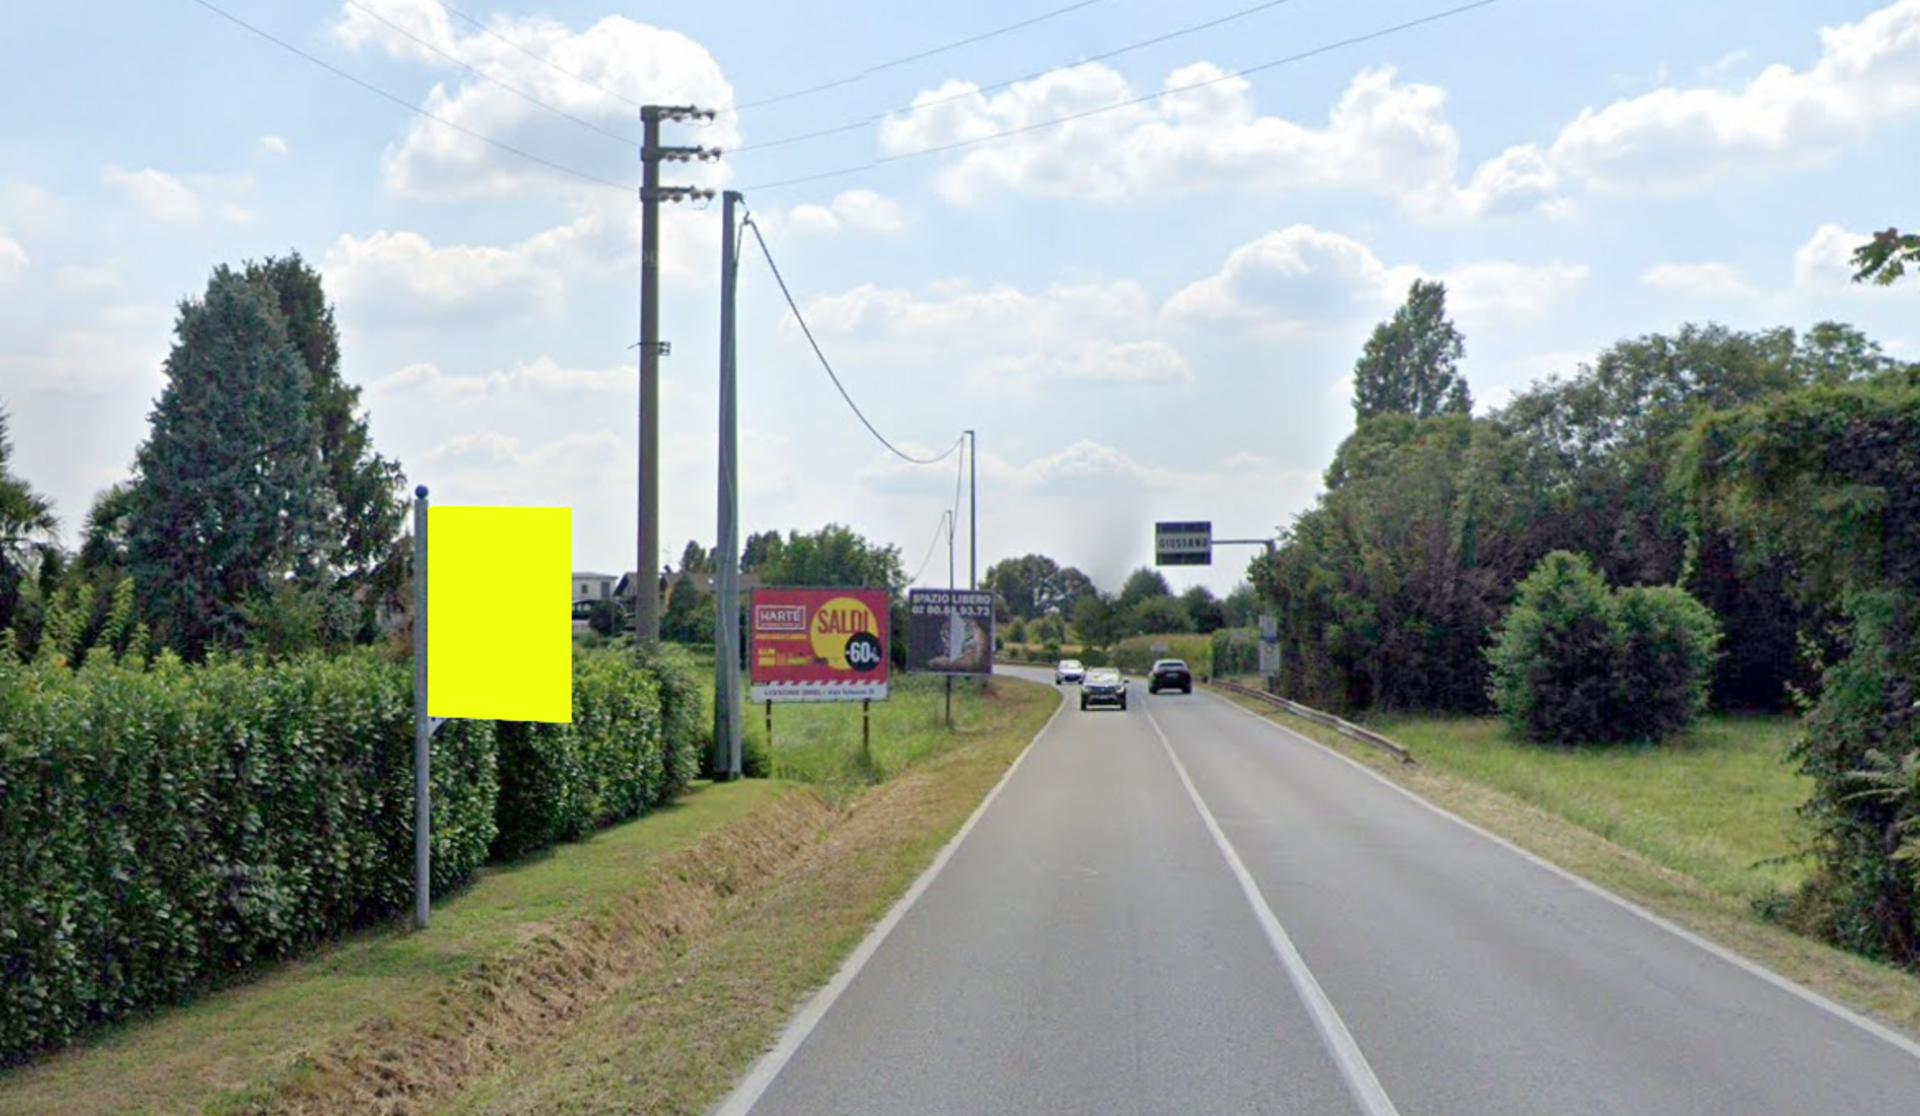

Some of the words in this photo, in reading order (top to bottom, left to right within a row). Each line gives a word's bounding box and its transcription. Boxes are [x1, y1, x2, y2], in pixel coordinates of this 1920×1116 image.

[912, 593, 949, 604] SPAZIO
[952, 594, 991, 605] LIBERO
[817, 609, 868, 634] SALDI
